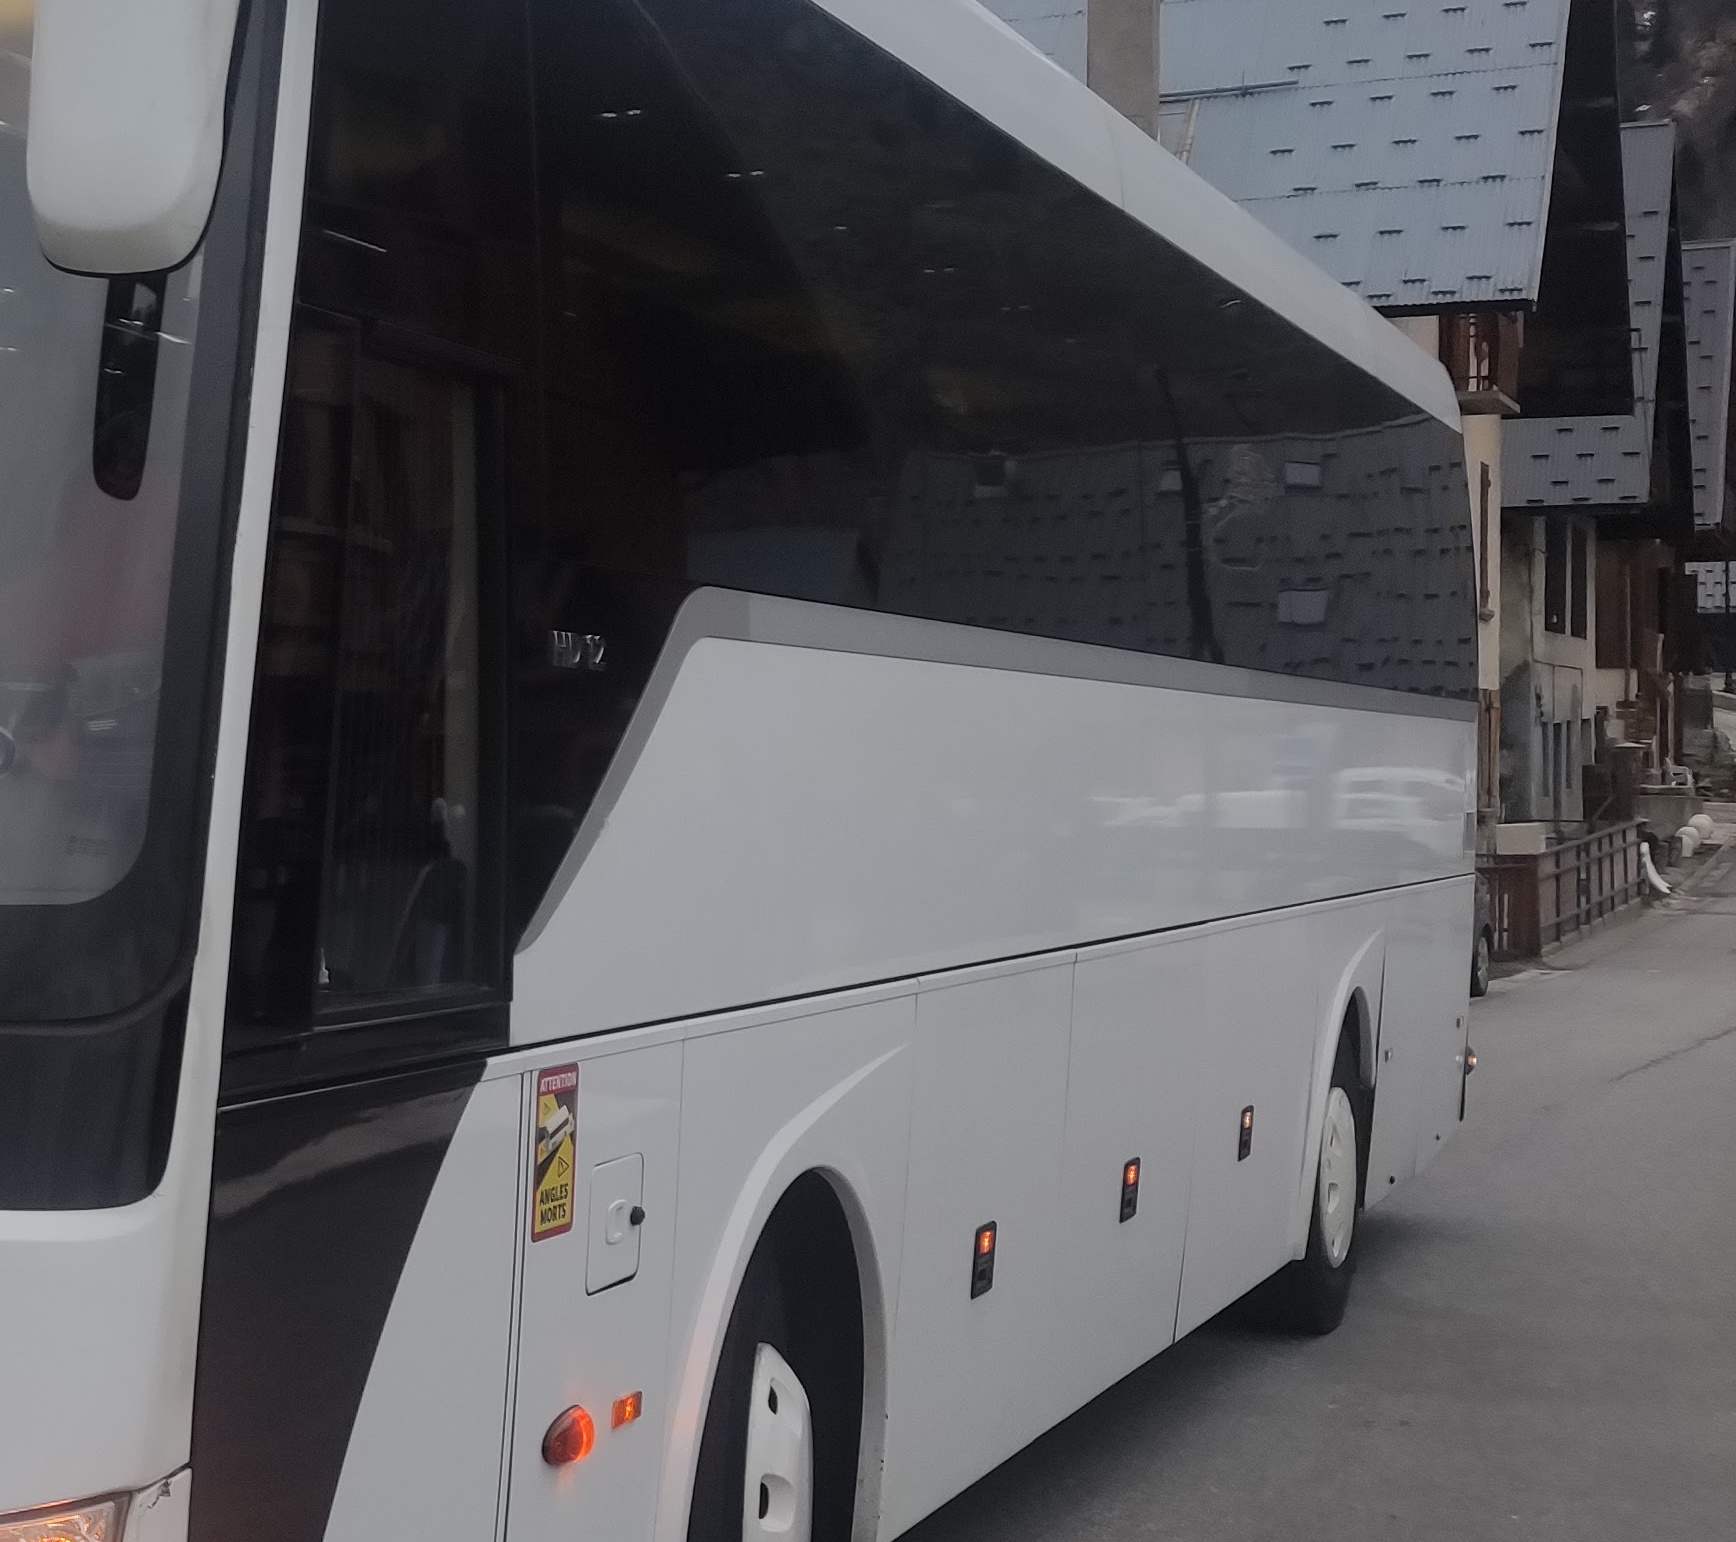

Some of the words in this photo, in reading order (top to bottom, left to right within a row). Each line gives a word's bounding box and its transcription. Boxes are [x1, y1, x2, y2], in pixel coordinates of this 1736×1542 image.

[540, 1071, 577, 1093] ATTENTION
[539, 1182, 569, 1206] ANGLES
[540, 1203, 567, 1226] MORTS
